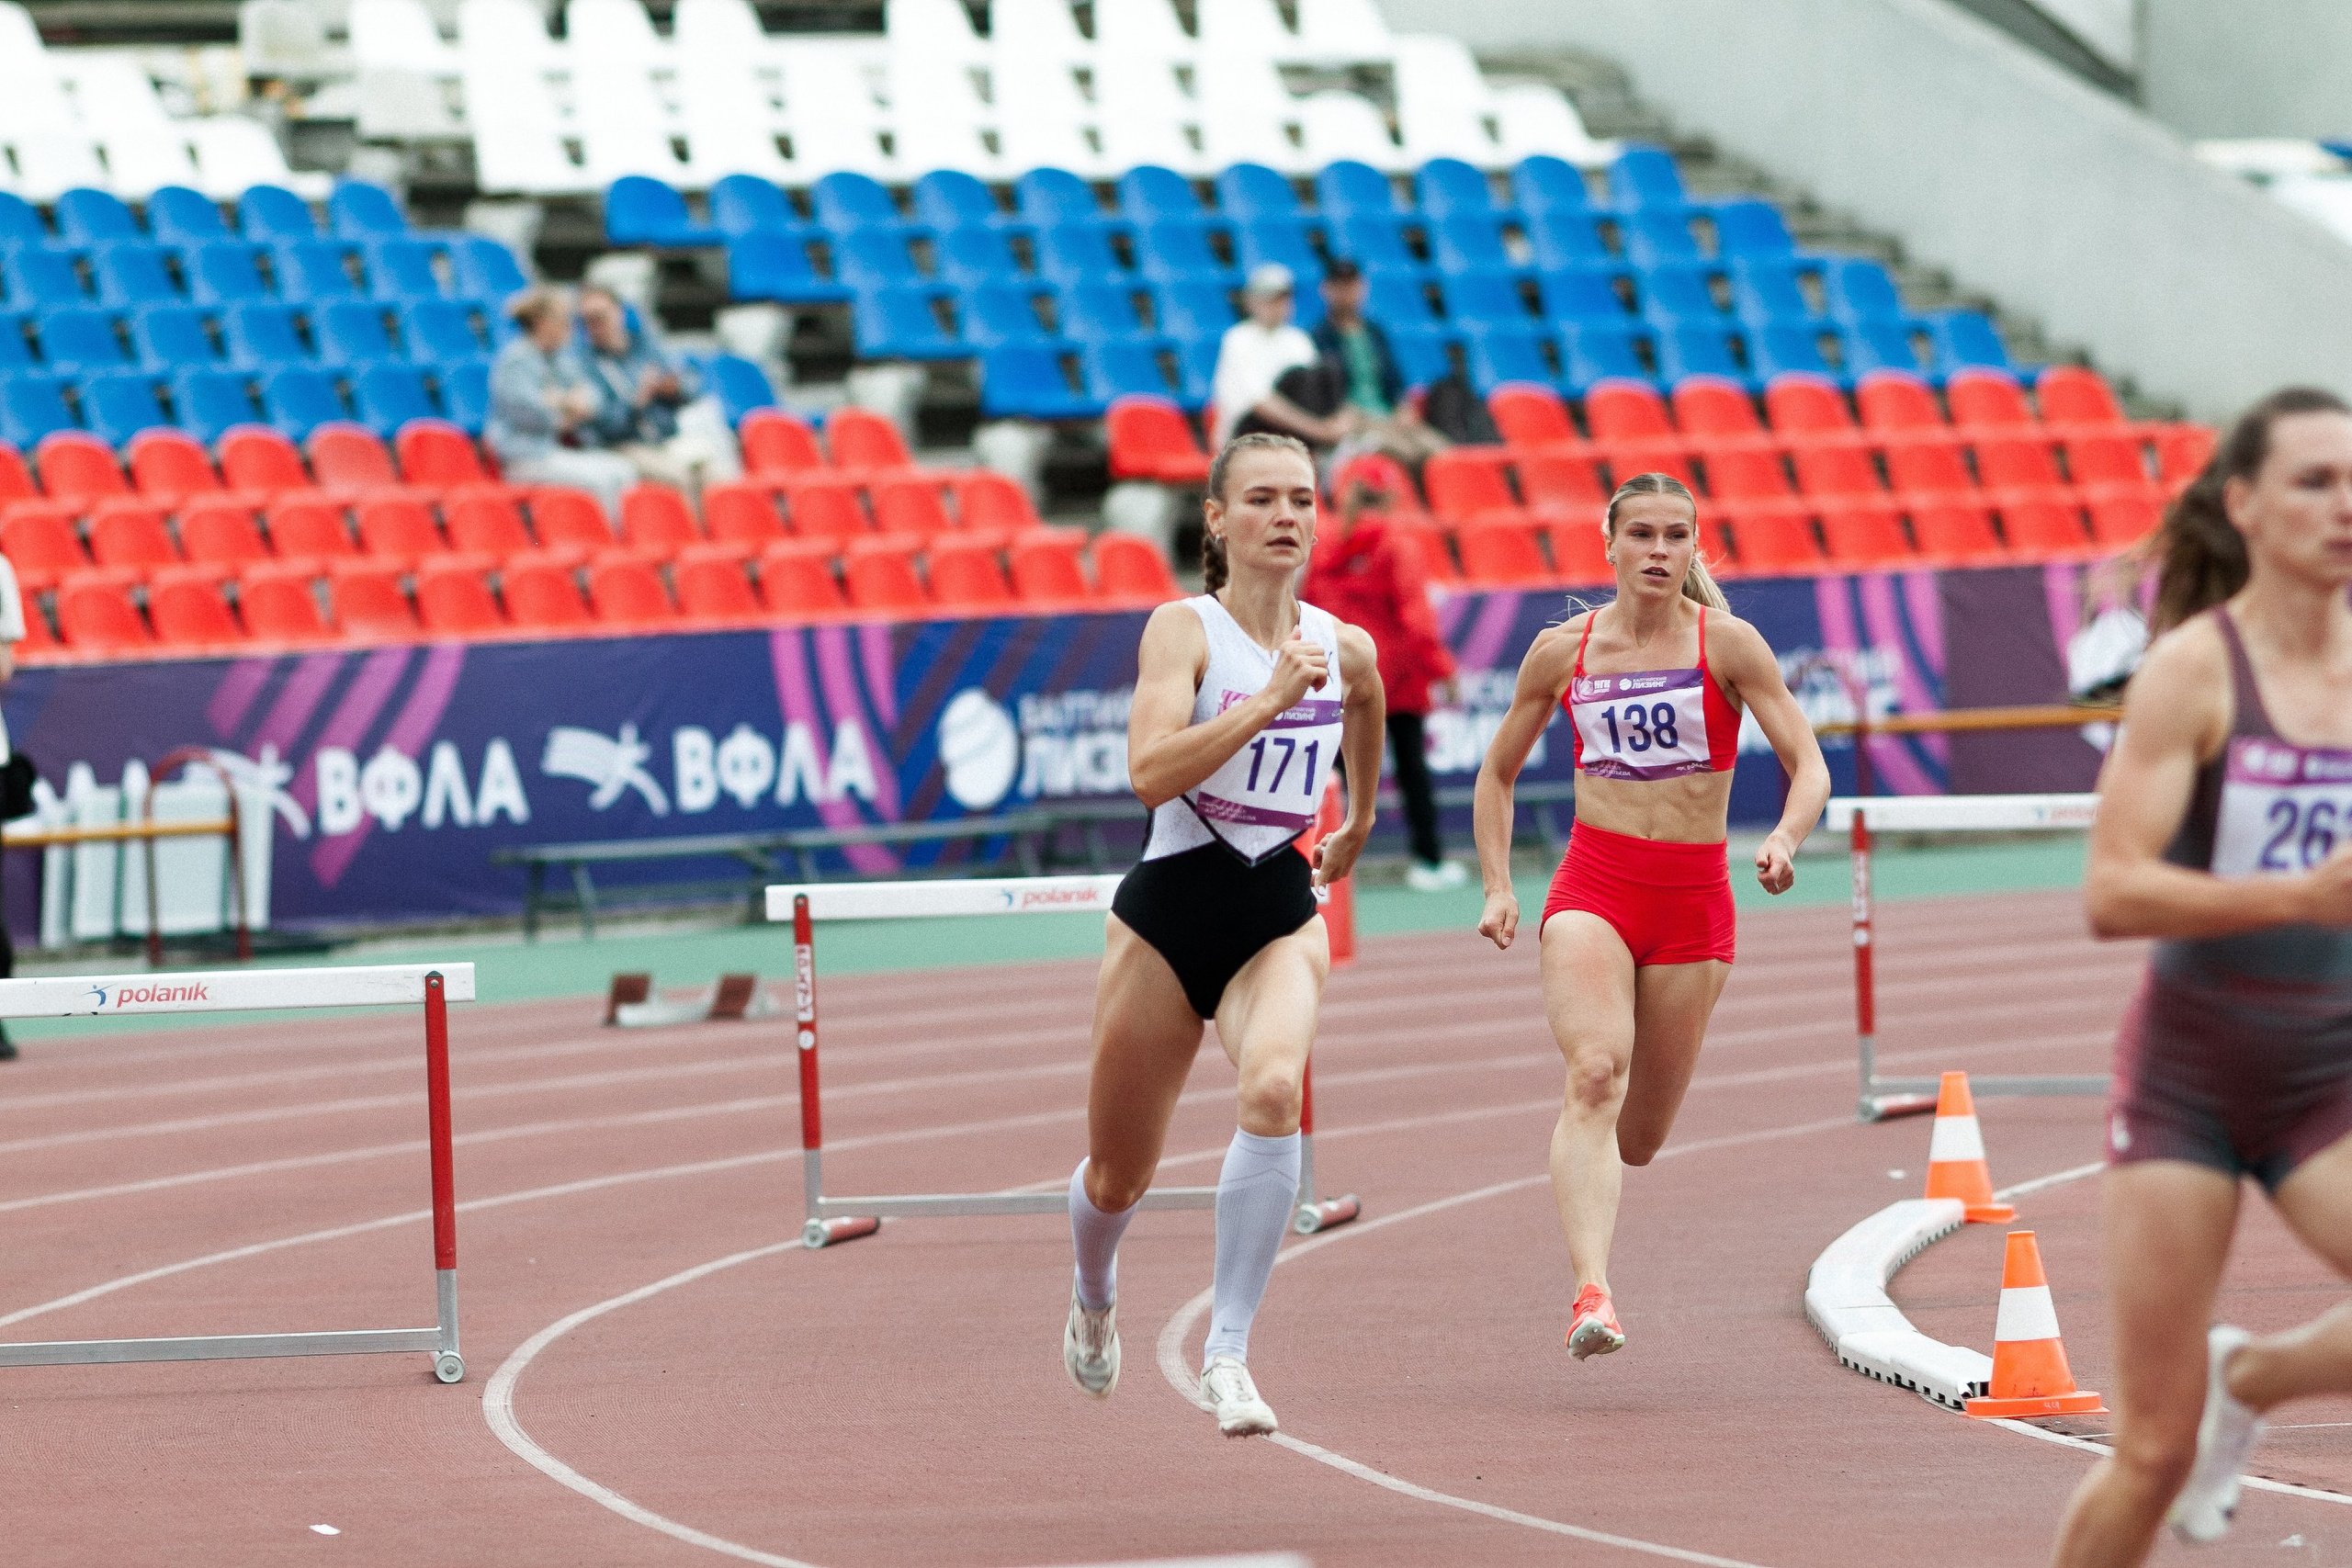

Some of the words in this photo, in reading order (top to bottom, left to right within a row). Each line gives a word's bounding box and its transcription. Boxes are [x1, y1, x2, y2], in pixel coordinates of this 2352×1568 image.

[1632, 681, 1667, 690] ЛИЗИНГ
[1601, 703, 1679, 753] 138
[316, 737, 532, 836] ВФЛА
[673, 717, 878, 815] ВФЛА
[1247, 737, 1319, 796] 171
[2258, 798, 2352, 871] 26
[1023, 887, 1098, 909] polanik
[117, 981, 209, 1009] polanik
